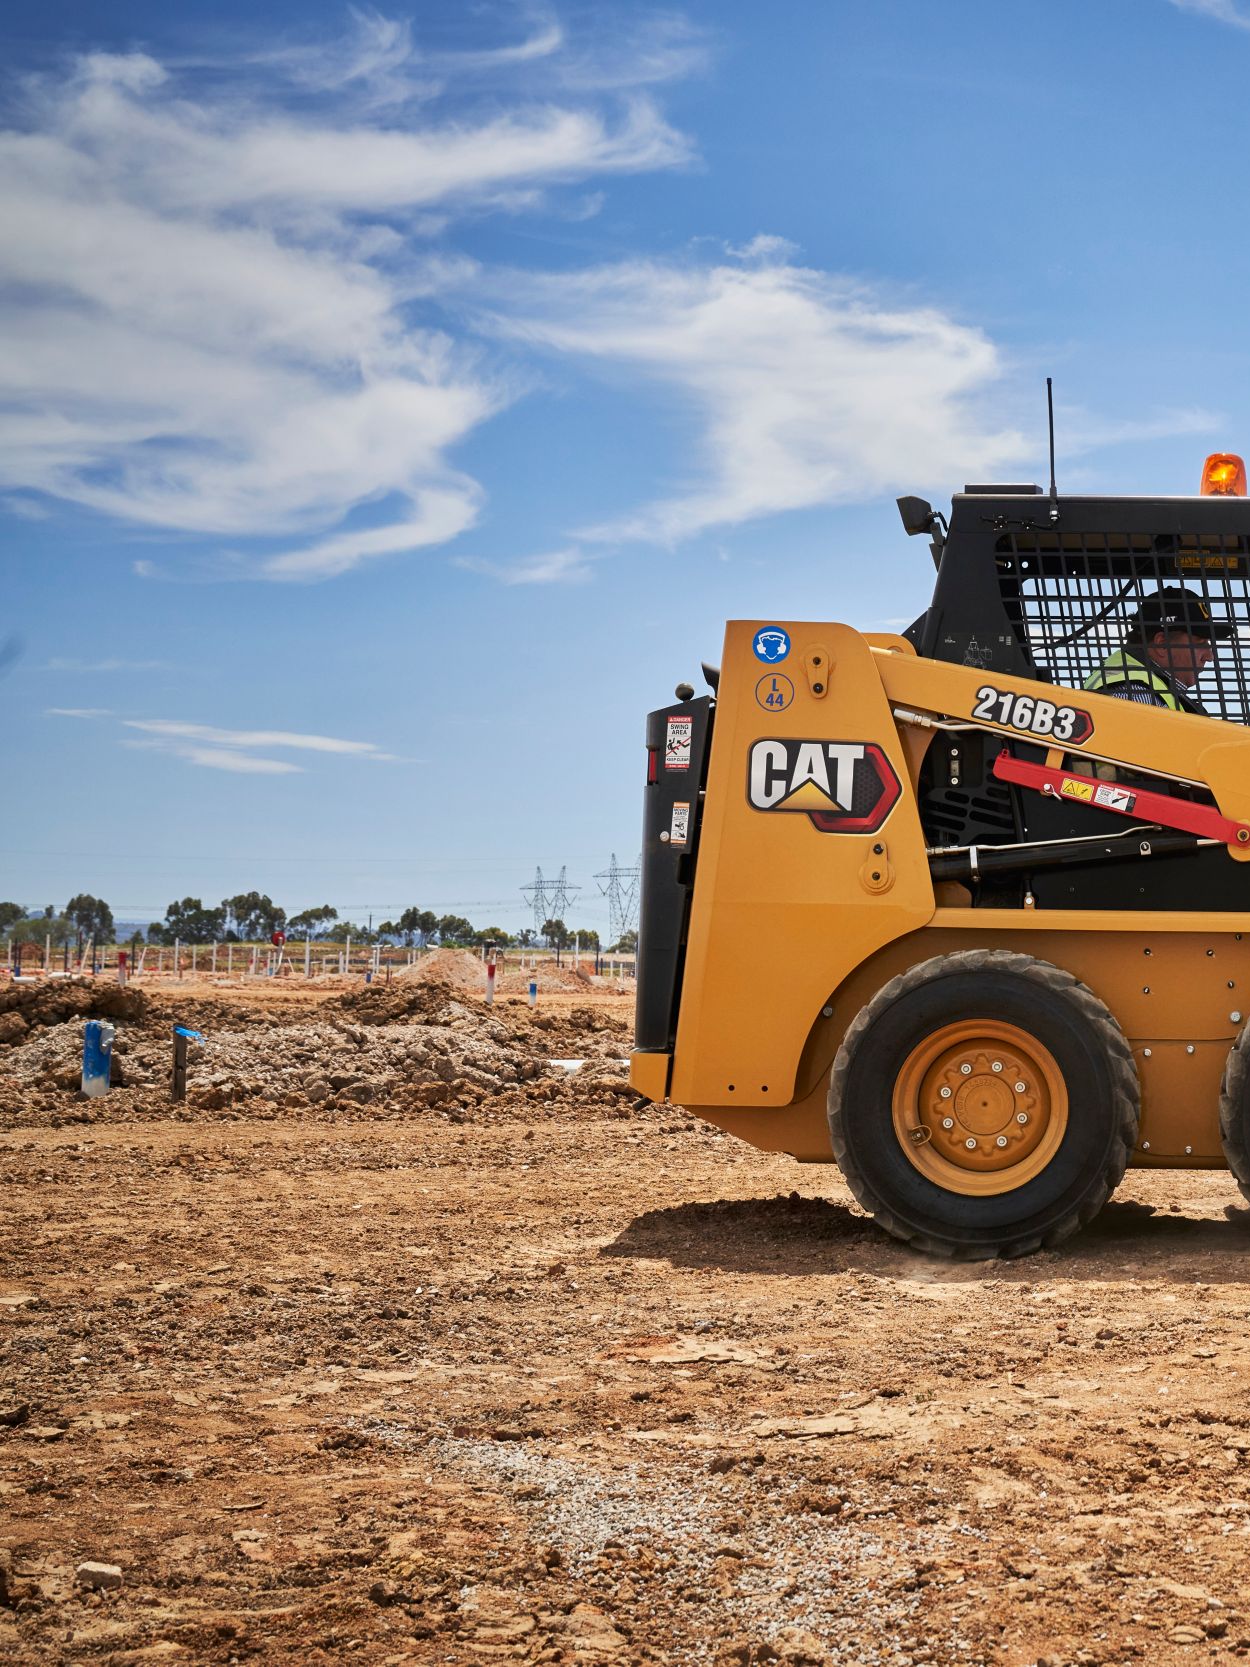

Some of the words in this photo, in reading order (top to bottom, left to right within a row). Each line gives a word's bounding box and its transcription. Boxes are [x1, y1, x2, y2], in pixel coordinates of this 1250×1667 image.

[766, 693, 784, 706] 44
[772, 678, 779, 691] L
[973, 687, 1076, 739] 216B3
[751, 740, 864, 811] CAT
